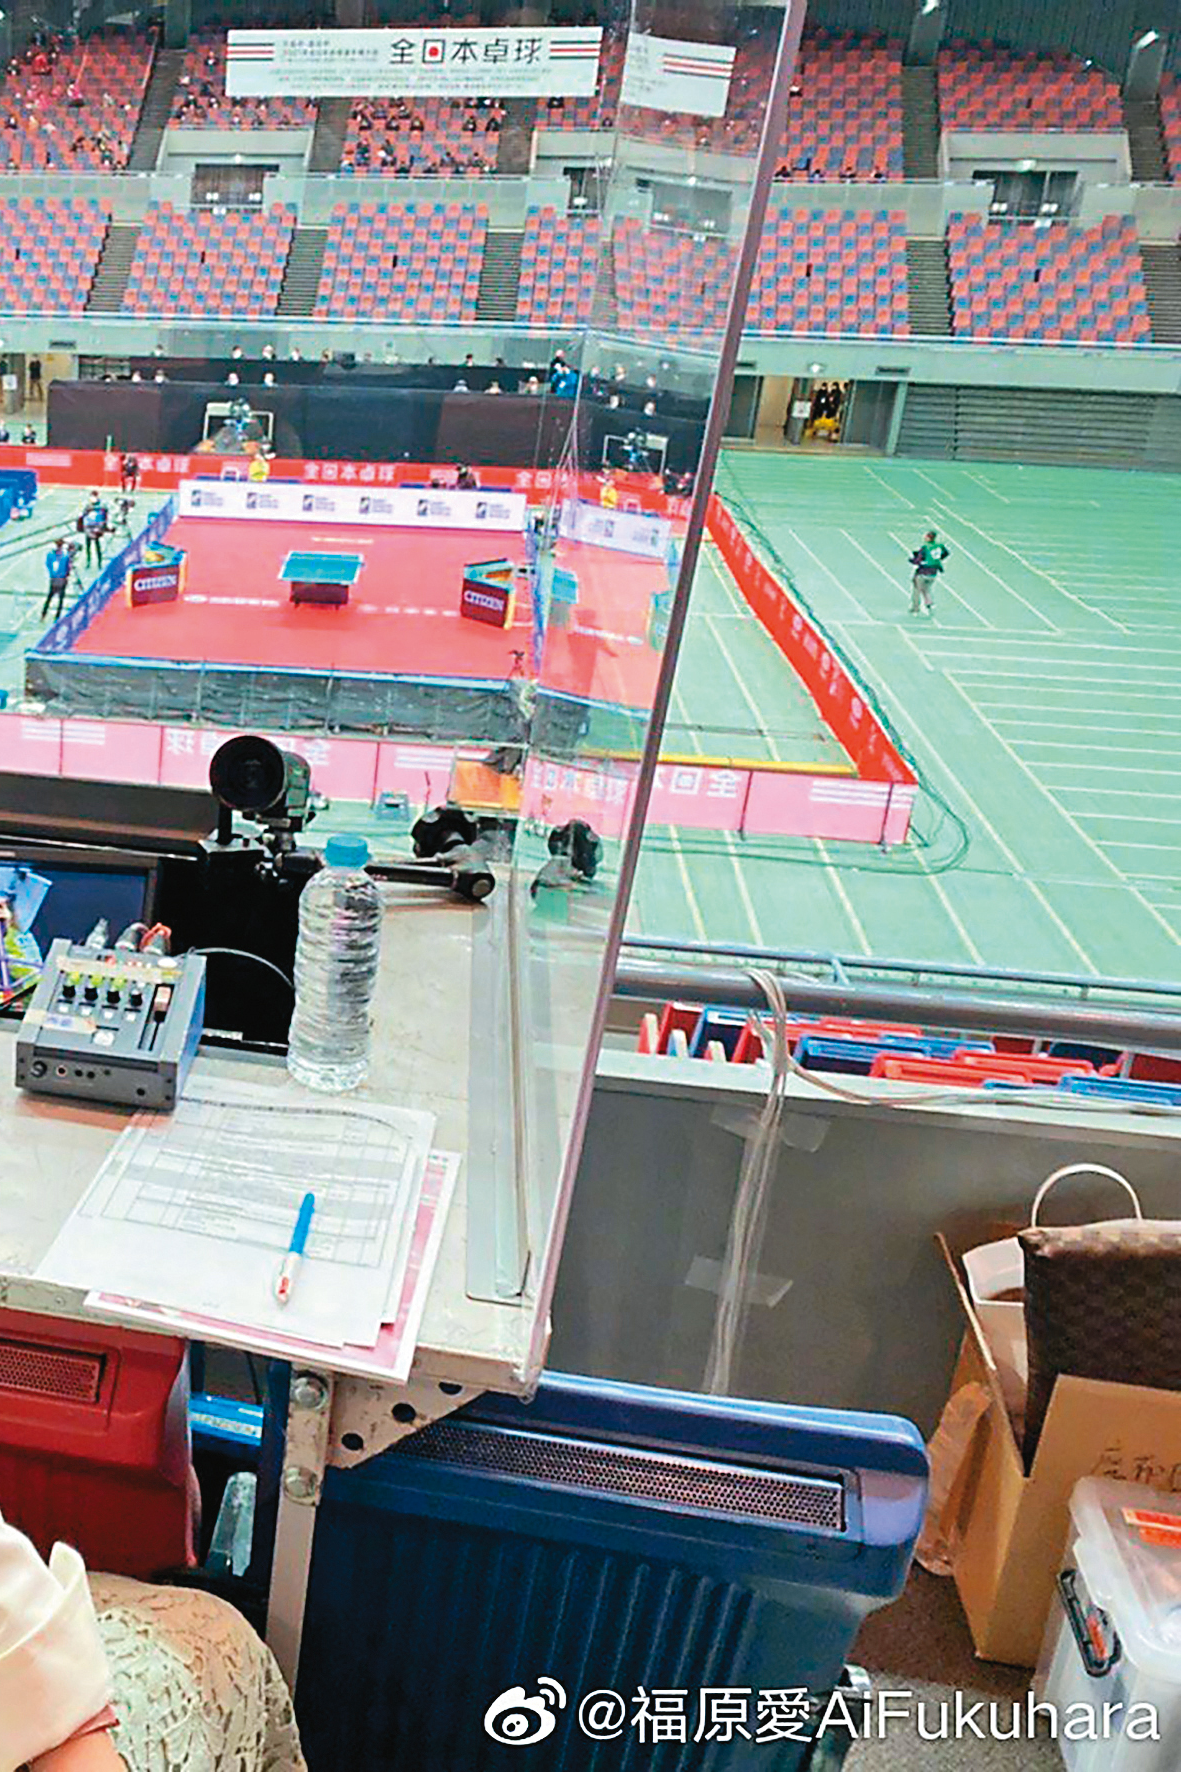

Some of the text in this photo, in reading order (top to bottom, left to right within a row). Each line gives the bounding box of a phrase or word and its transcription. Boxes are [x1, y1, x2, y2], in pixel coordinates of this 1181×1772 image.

[389, 37, 543, 65] 全日本卓球
[134, 574, 177, 592] CITIZEN
[464, 590, 504, 611] CITIZEN
